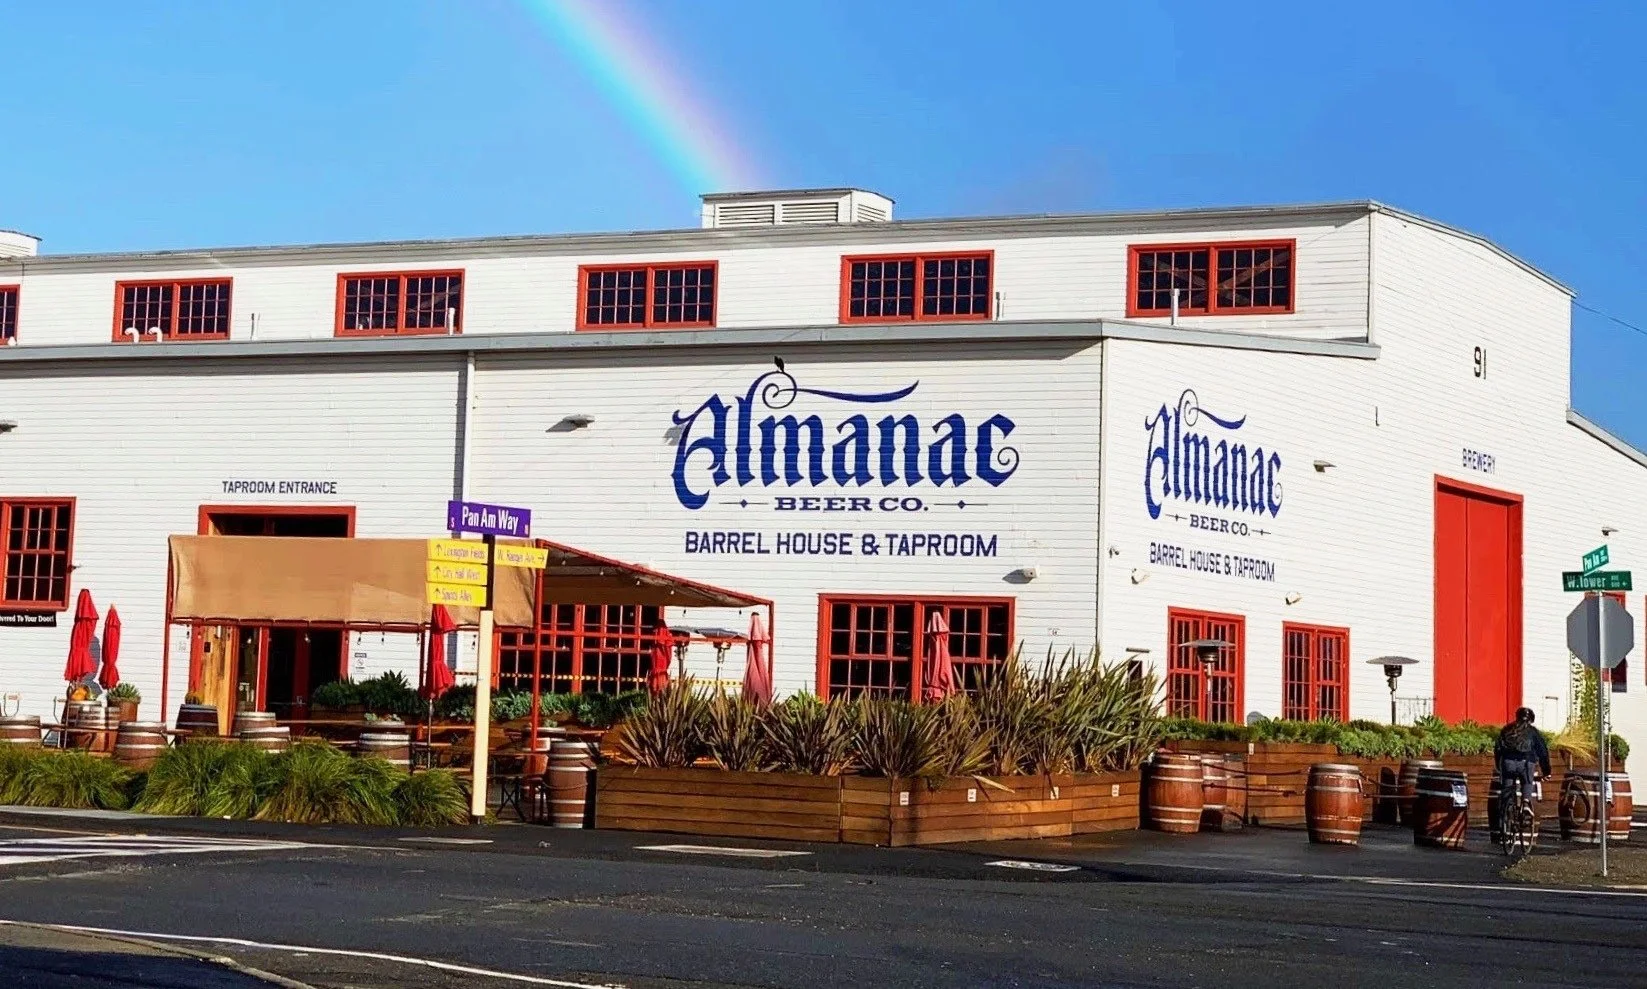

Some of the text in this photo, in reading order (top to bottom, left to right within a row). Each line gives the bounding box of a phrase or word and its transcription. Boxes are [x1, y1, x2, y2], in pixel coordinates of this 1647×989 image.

[1474, 346, 1487, 380] 91
[671, 371, 1020, 511] Almanac
[1144, 388, 1283, 520] Almanac
[1462, 448, 1496, 475] BREWERY
[222, 480, 338, 495] TAPROOM ENTRANCE
[774, 496, 930, 512] BEER CO.
[462, 505, 480, 527] Pan
[481, 507, 496, 529] Am
[498, 509, 519, 535] Way
[1189, 514, 1251, 537] BEER CO.
[685, 531, 998, 558] BARREL HOUSE & TAPROOM
[1149, 541, 1275, 582] BARREL HOUSE & TAPROOM
[17, 614, 24, 622] To
[24, 614, 38, 623] Your
